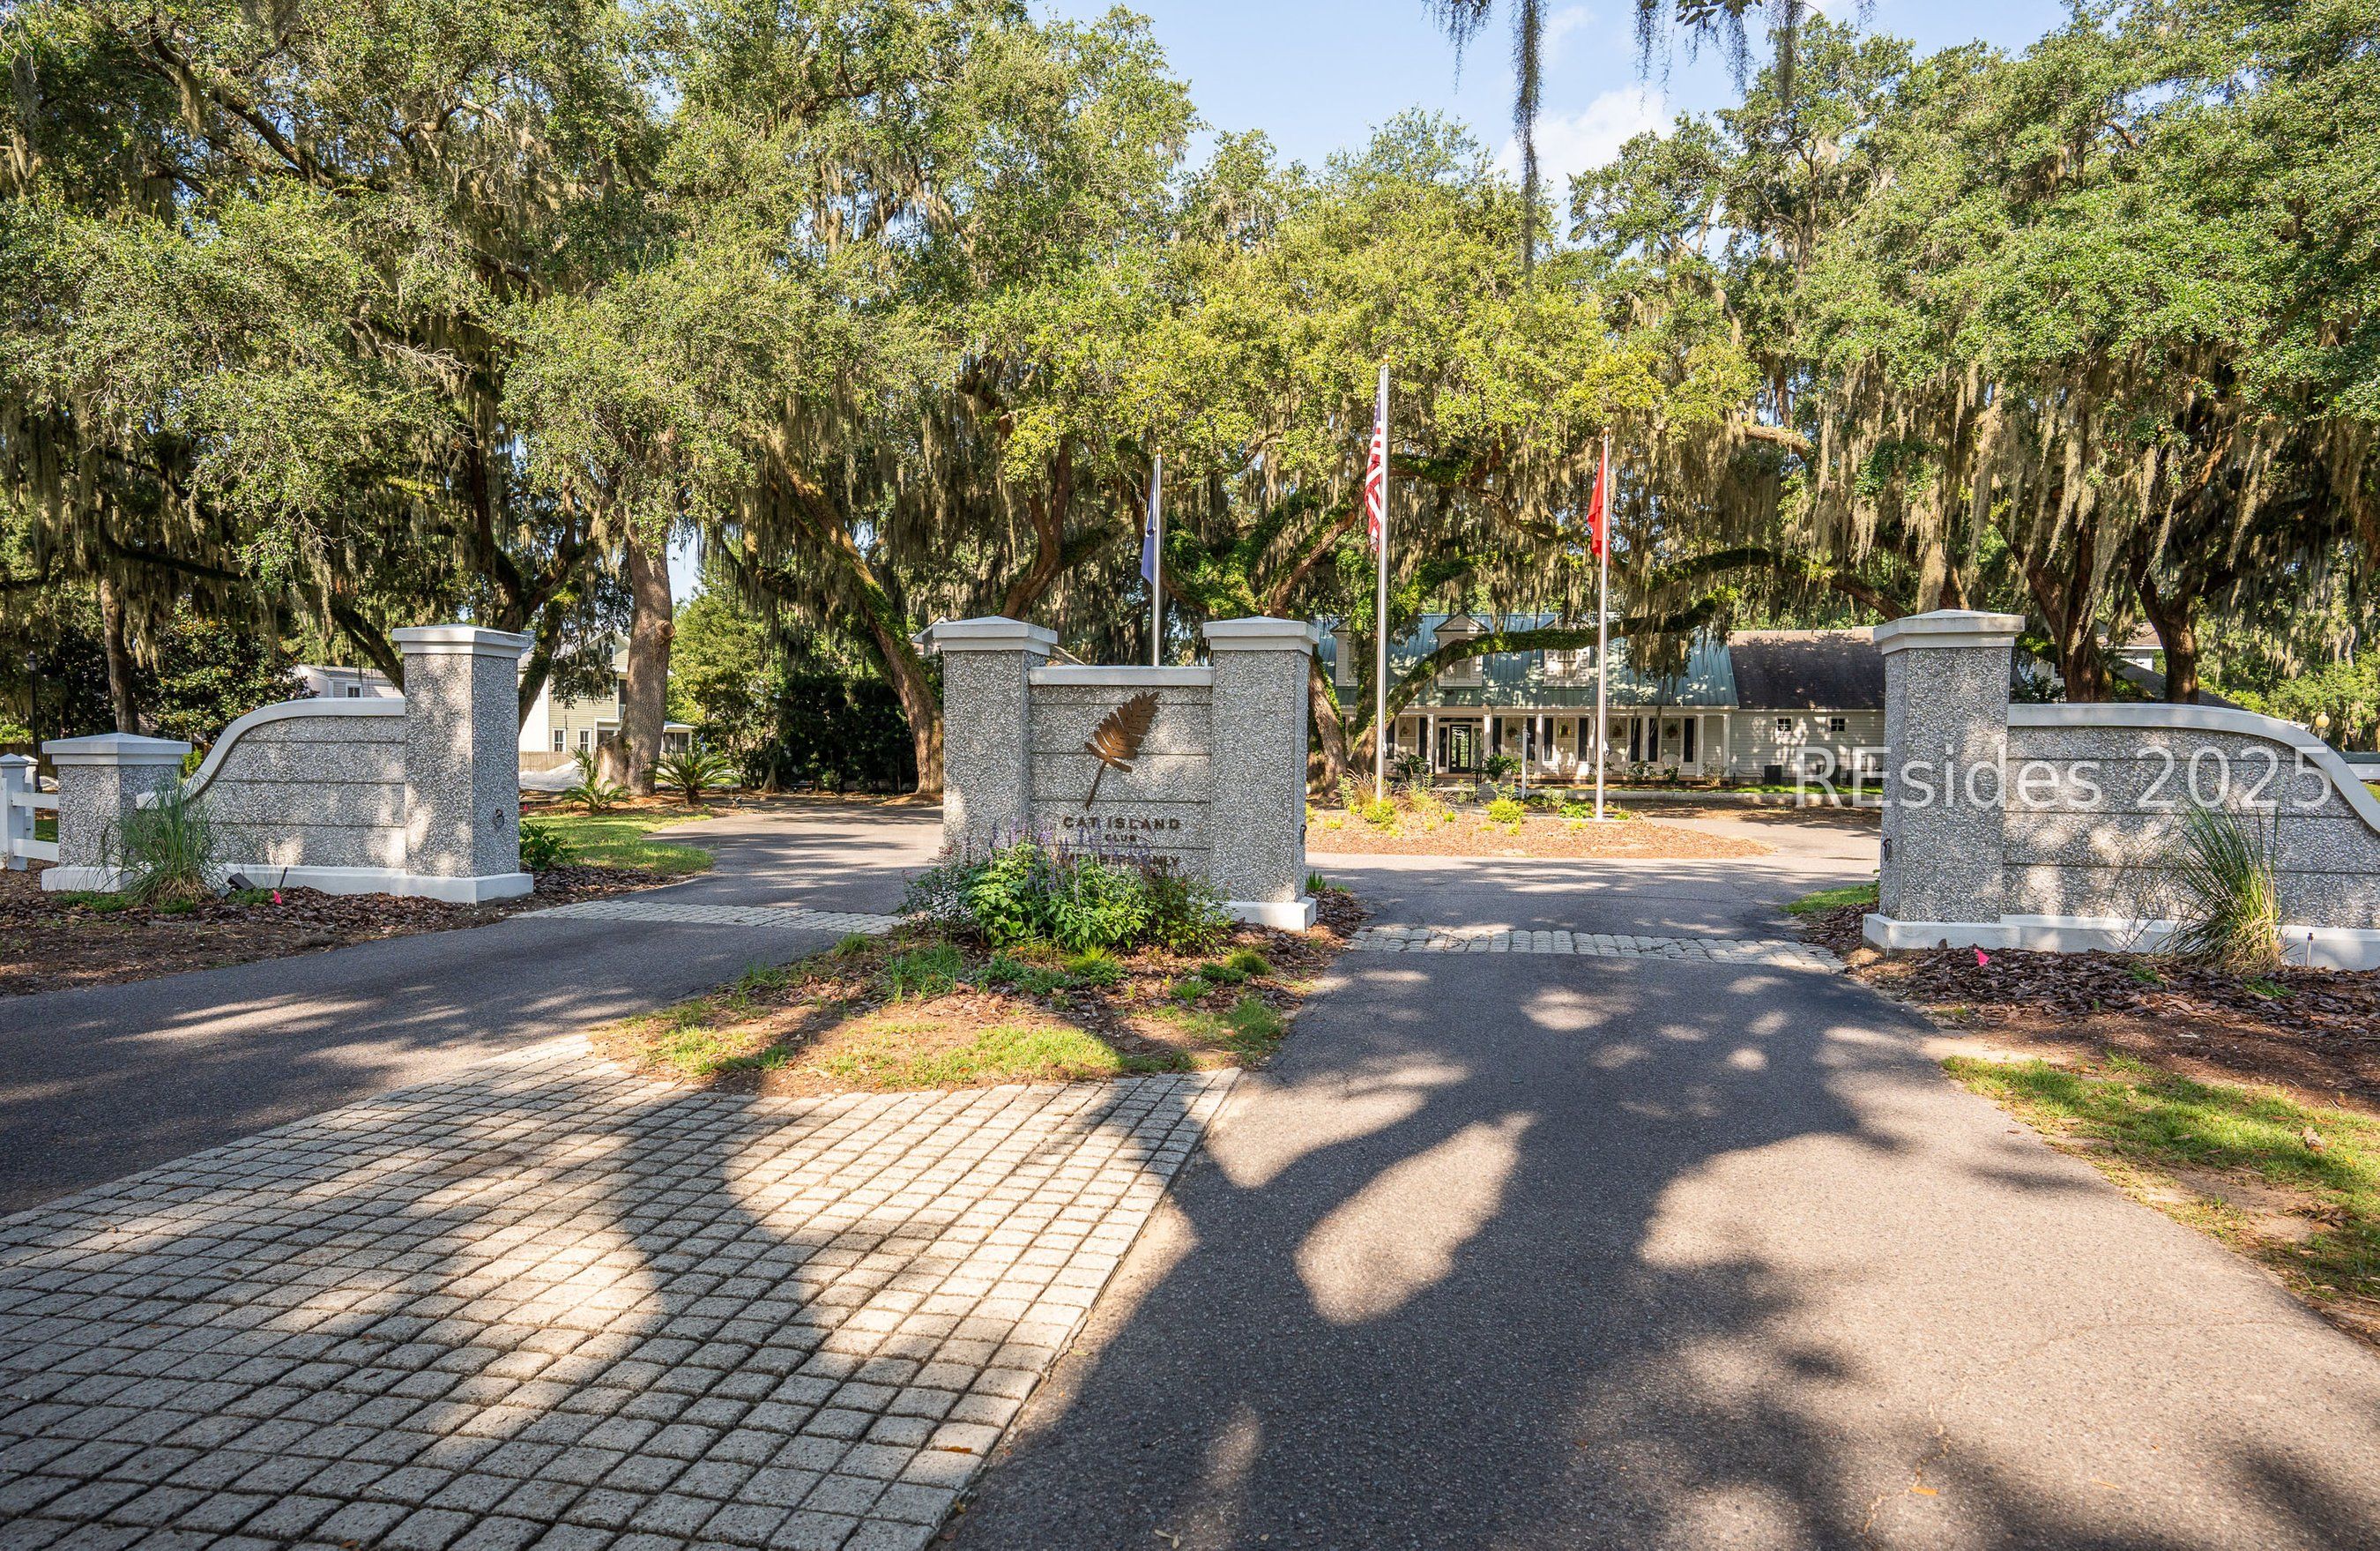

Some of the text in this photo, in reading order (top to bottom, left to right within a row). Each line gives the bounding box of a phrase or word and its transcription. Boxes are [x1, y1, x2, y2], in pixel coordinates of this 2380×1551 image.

[1063, 817, 1180, 831] CAT ISLAND
[1104, 833, 1138, 843] CLUB
